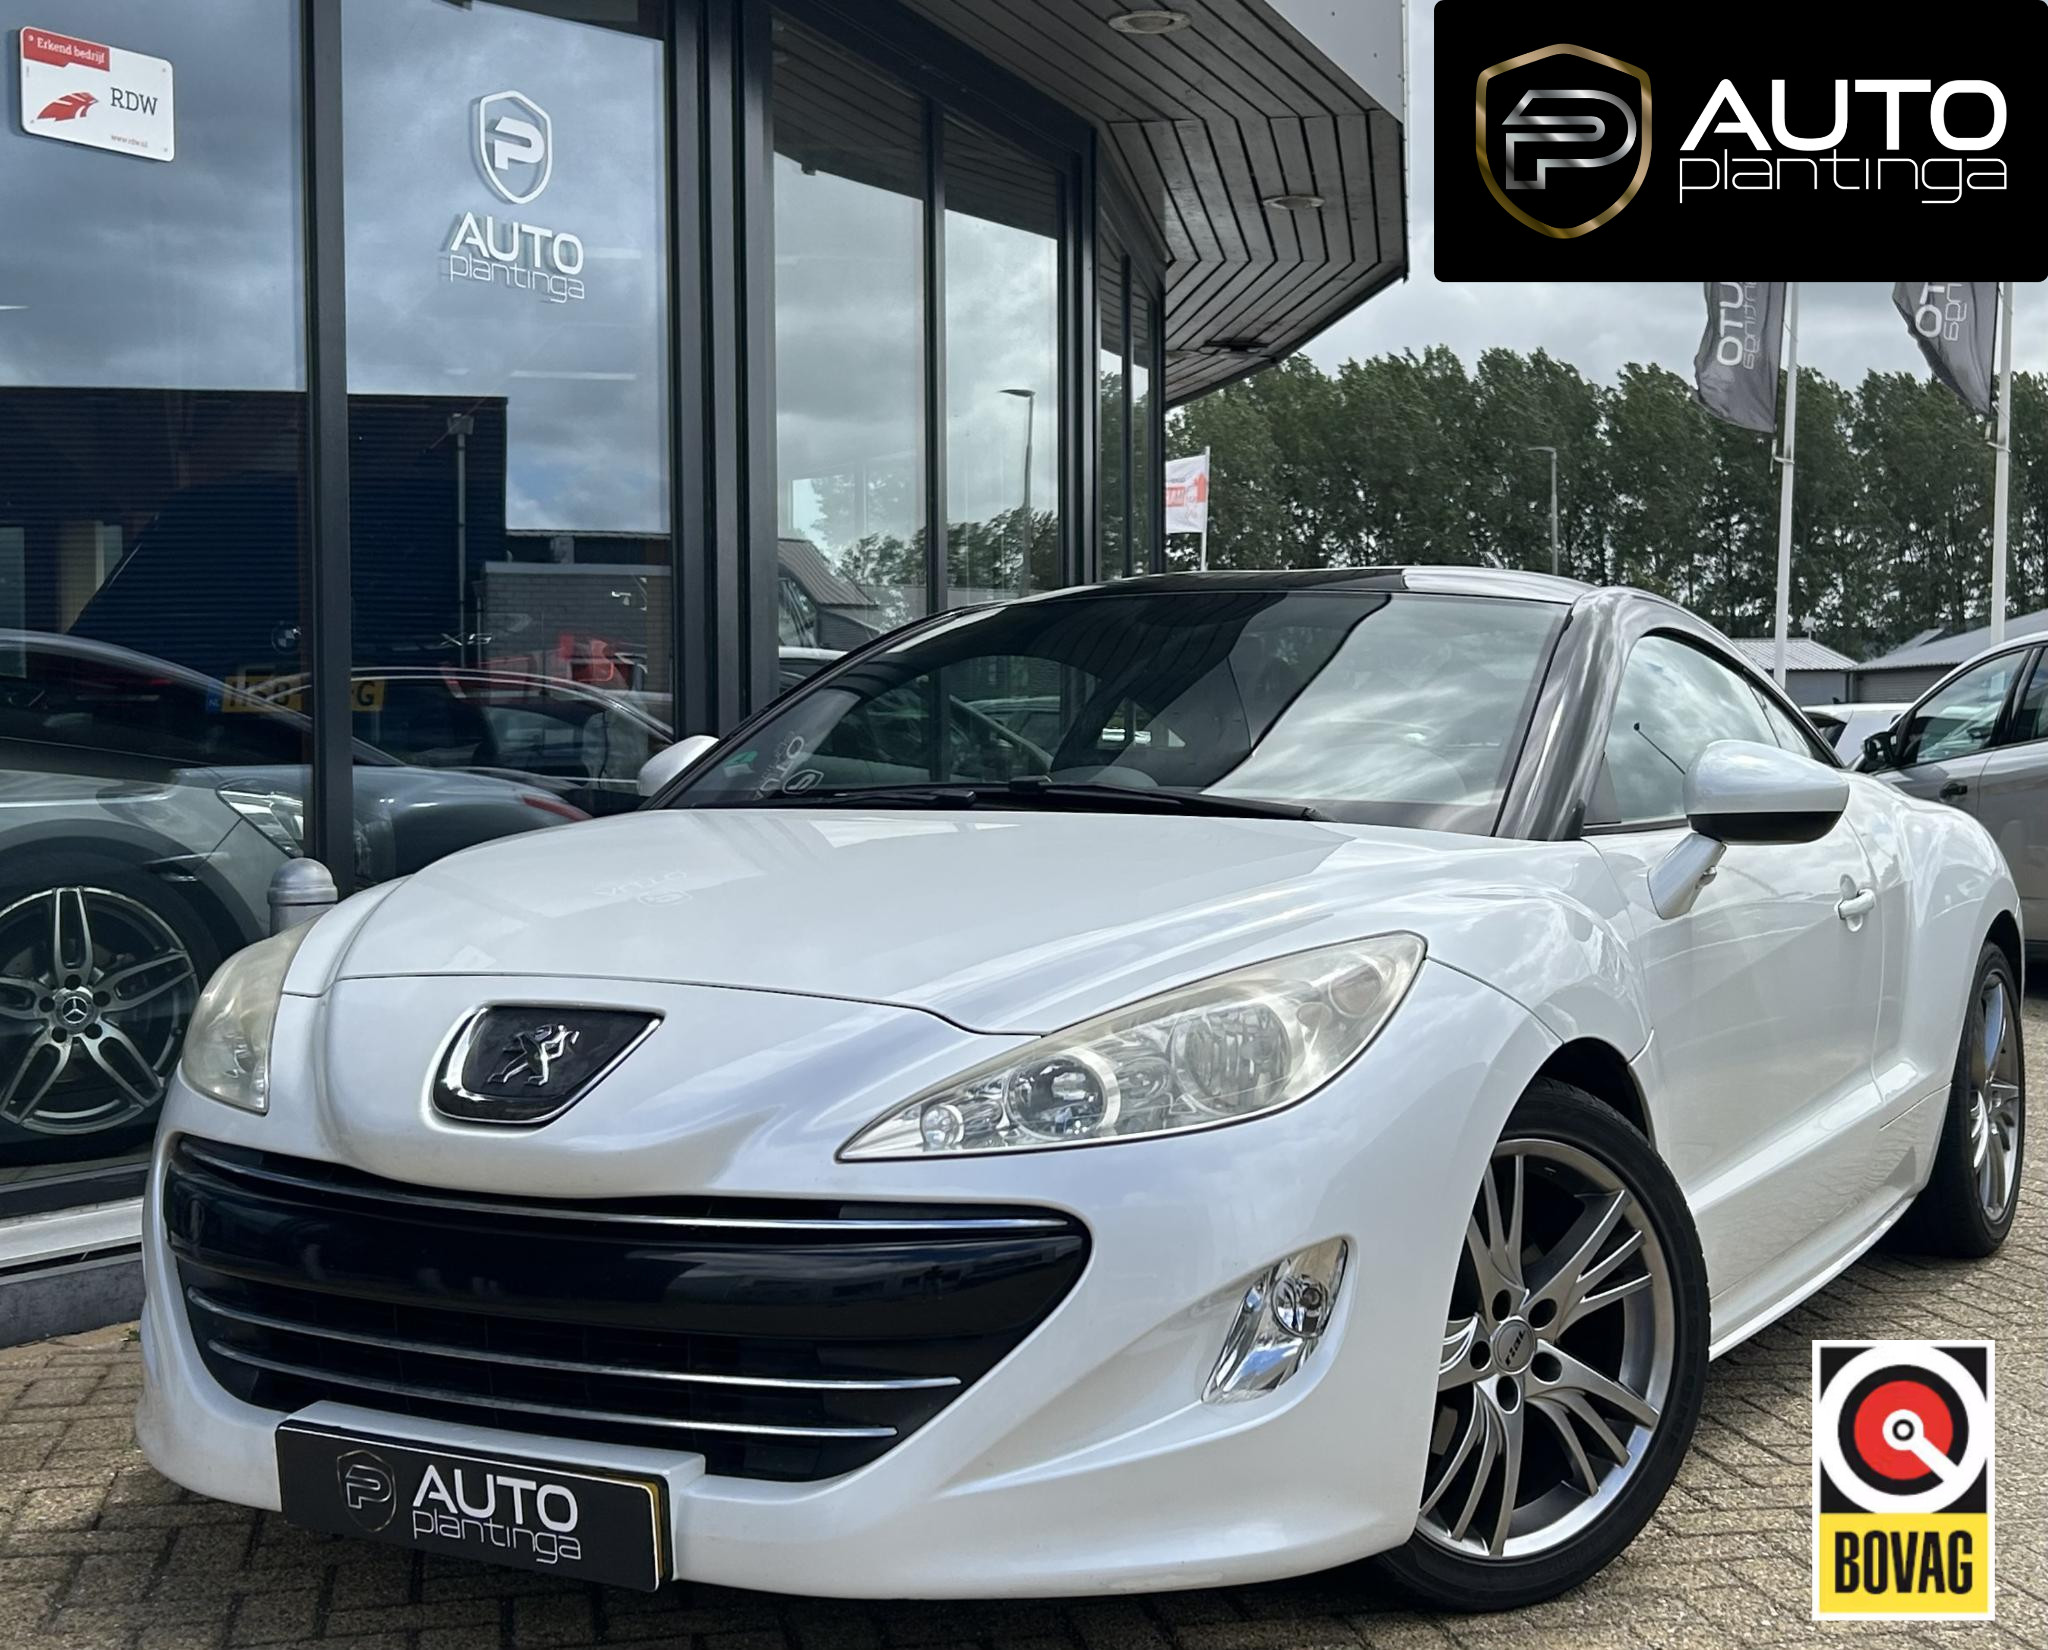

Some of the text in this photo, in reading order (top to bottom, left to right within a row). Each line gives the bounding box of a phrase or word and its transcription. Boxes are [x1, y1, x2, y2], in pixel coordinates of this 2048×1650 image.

[36, 36, 105, 65] Erkend bedrijf
[110, 86, 158, 117] RDW
[450, 211, 584, 275] AUTO
[450, 253, 585, 303] plantinga
[412, 1463, 579, 1533] AUTO
[411, 1507, 582, 1565] plantinga
